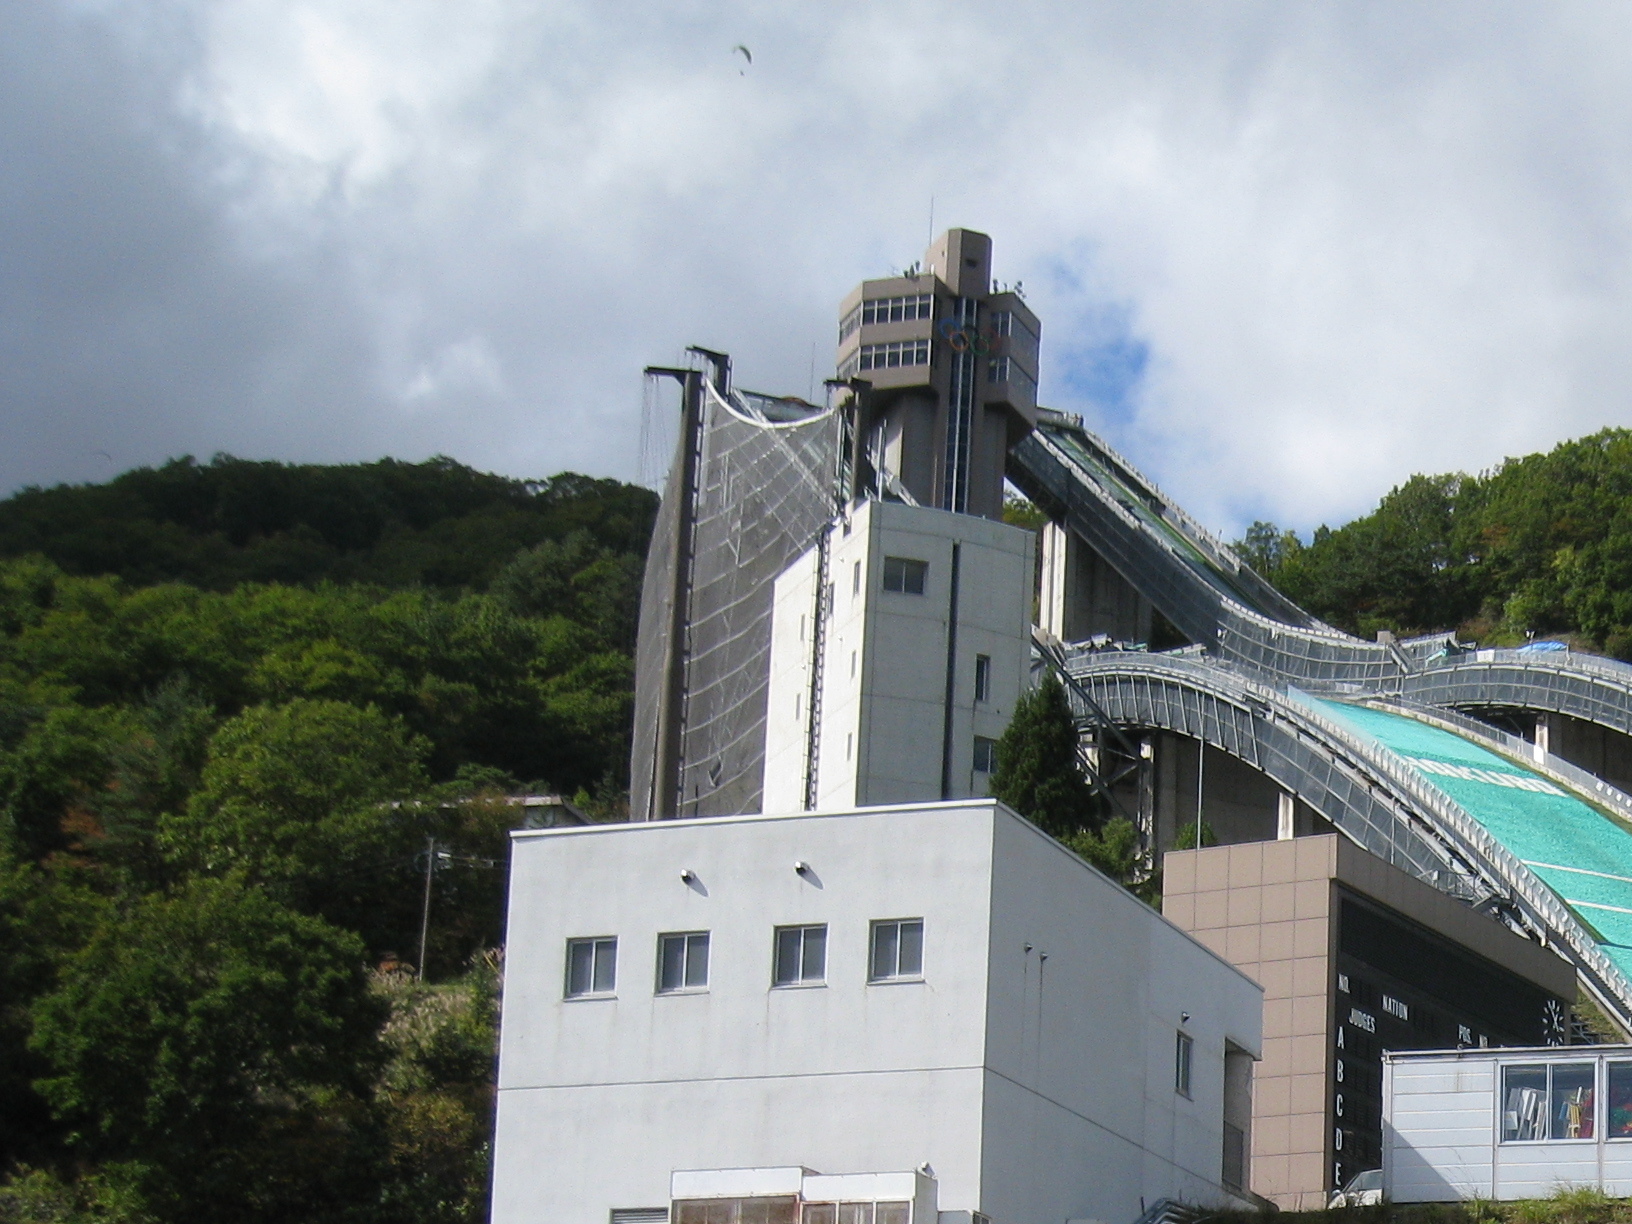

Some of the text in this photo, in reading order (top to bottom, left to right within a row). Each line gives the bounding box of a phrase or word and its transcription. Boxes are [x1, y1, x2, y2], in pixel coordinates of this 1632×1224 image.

[1382, 994, 1408, 1021] NATION
[1349, 1007, 1376, 1034] JUDGES
[1337, 1026, 1345, 1050] A
[1336, 1060, 1344, 1083] B
[1336, 1093, 1343, 1117] C
[1335, 1128, 1343, 1151] D
[1335, 1163, 1342, 1186] E
